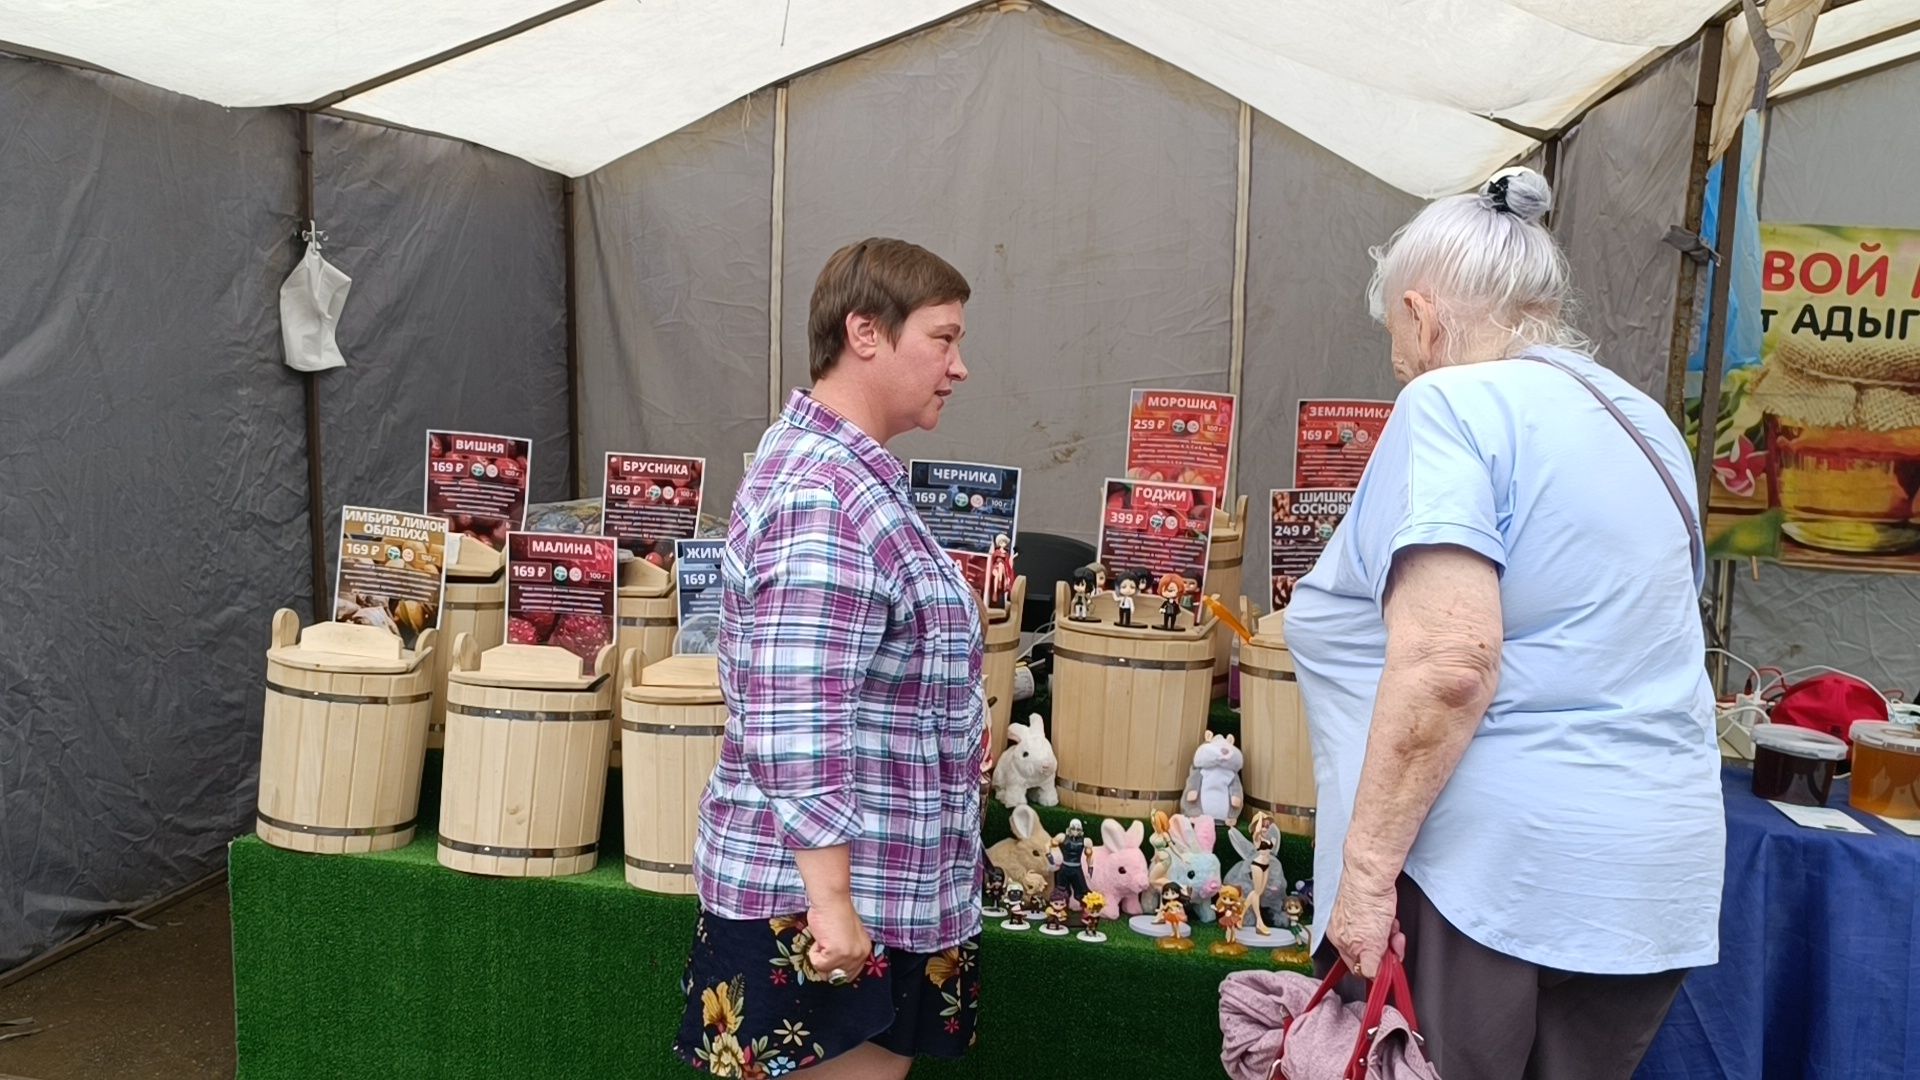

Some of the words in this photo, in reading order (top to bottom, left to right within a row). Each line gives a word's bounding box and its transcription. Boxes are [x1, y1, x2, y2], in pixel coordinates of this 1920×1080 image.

[1791, 303, 1920, 342] АДЫГ
[1148, 396, 1217, 411] МОРОШКА
[1133, 419, 1155, 430] 259
[1302, 430, 1322, 440] 169
[455, 439, 505, 454] ВИШНЯ
[432, 462, 453, 472] 169
[623, 461, 689, 475] БРУСНИКА
[933, 468, 997, 484] ЧЕРНИКА
[610, 484, 631, 496] 169
[1135, 487, 1187, 502] ГОДЖИ
[915, 492, 937, 503] 169
[345, 510, 400, 526] ИМБИРЬ
[401, 516, 446, 533] ЛИМОН
[1110, 511, 1134, 524] 399
[363, 523, 430, 542] ОБЛЕПИХА
[1274, 525, 1300, 536] 249
[346, 543, 369, 555] 169
[532, 540, 593, 556] МАЛИНА
[513, 565, 535, 577] 169
[589, 571, 601, 580] 100
[683, 573, 706, 585] 169
